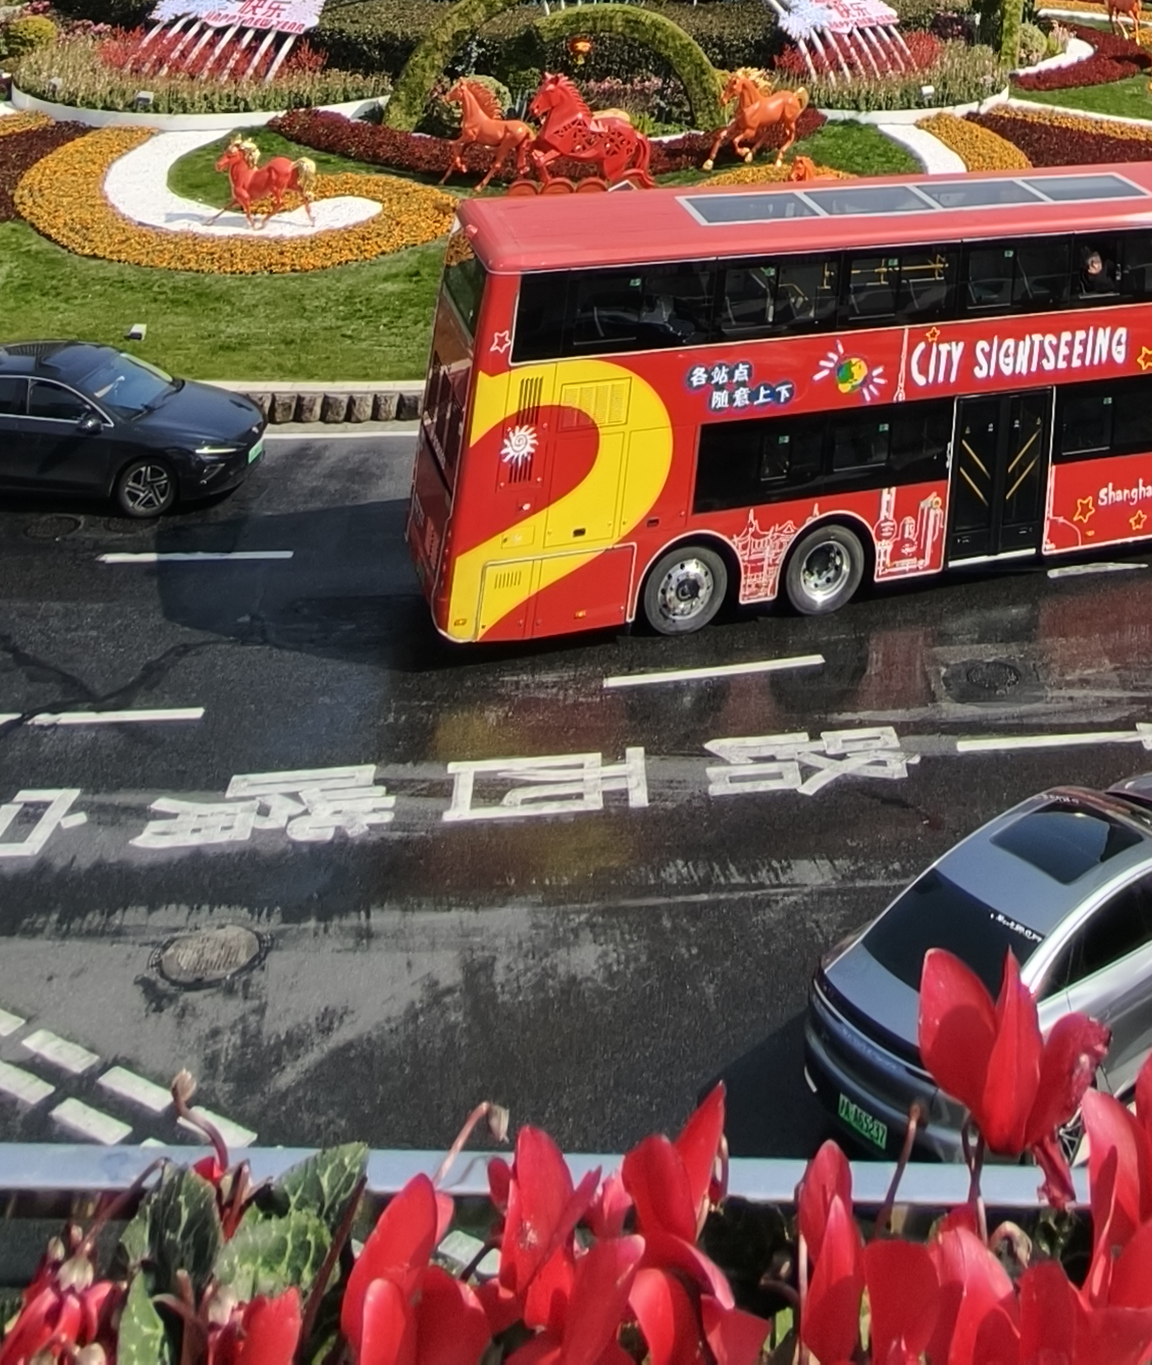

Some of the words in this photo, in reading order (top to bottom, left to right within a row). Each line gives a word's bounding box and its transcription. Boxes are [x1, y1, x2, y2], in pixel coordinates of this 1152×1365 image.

[204, 11, 242, 24] HAPPY
[244, 17, 273, 29] NEW
[274, 20, 306, 33] YEAR
[910, 340, 964, 386] CITY
[973, 326, 1128, 379] SIGHTSEEING
[689, 363, 750, 388] 各站点
[711, 384, 793, 409] 随意上下
